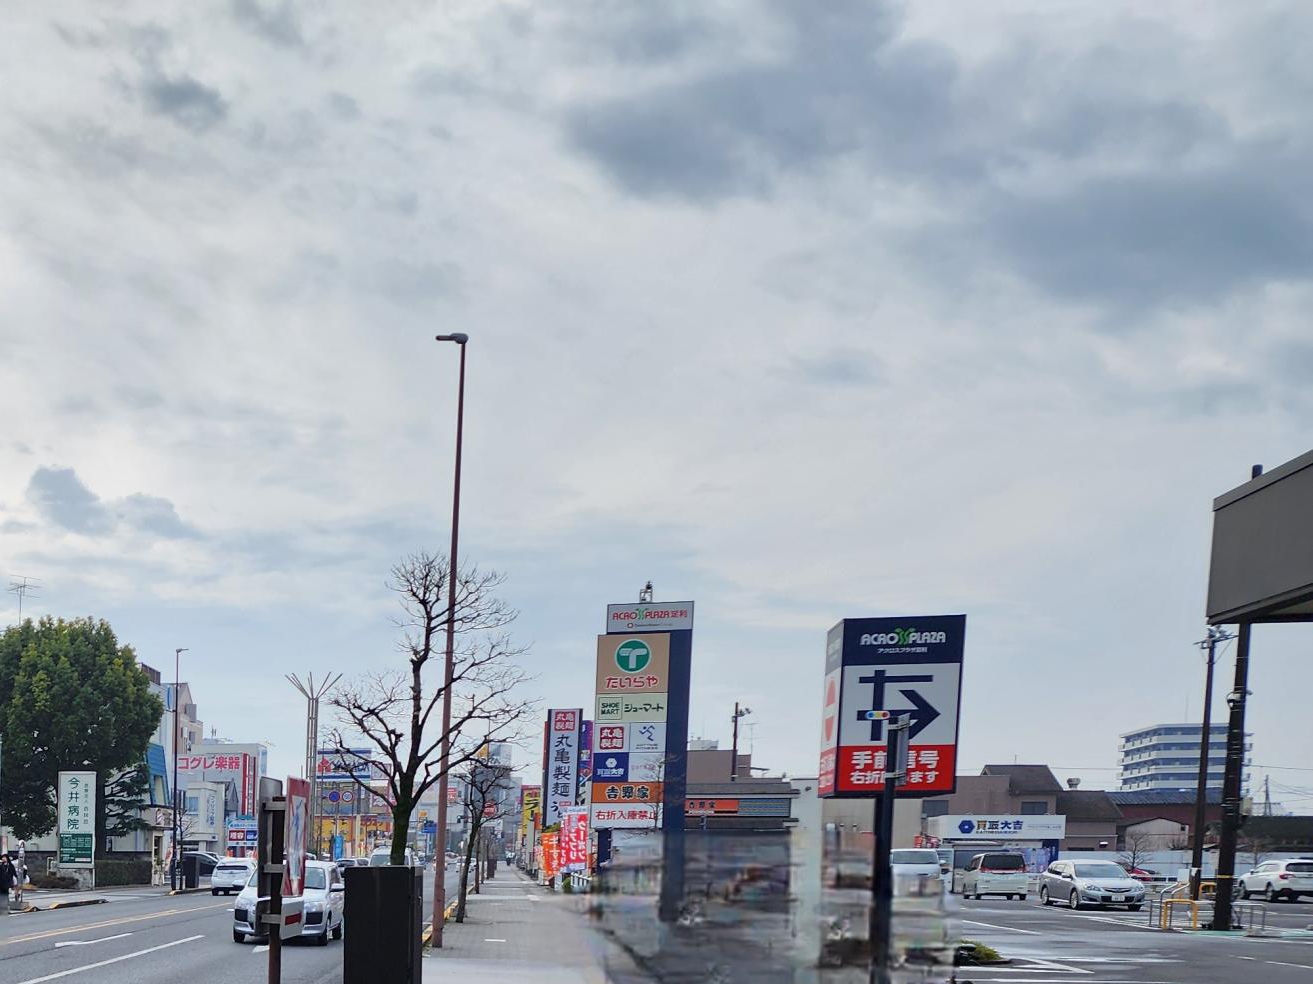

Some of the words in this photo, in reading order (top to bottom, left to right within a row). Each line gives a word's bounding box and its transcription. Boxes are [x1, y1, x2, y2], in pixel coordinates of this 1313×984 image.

[909, 631, 946, 644] PLAZA
[606, 676, 658, 689] たいらや
[624, 704, 663, 713] シューマート
[601, 728, 623, 738] 丸亀
[178, 755, 241, 770] コグレ楽器
[551, 734, 573, 797] 丸亀製麺
[68, 777, 80, 830] 今井病院
[976, 820, 1024, 831] 買取大吉
